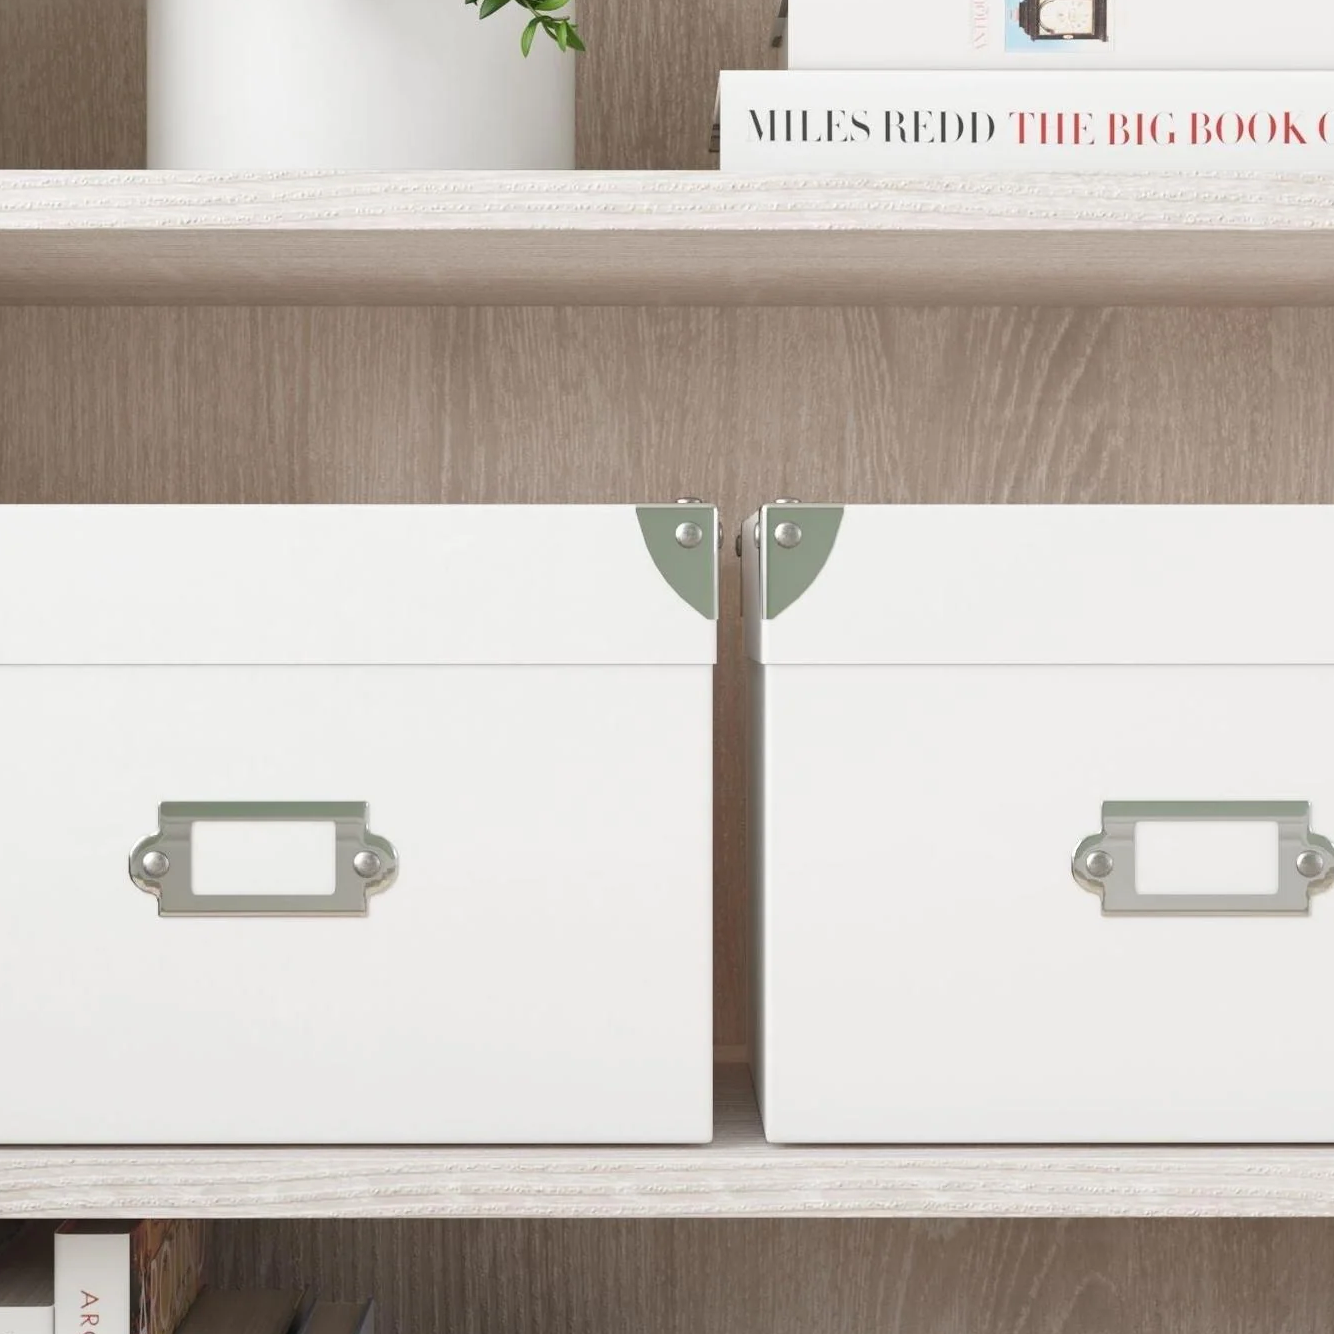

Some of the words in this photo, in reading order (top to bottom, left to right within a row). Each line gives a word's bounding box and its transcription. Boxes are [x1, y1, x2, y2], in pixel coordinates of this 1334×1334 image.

[746, 109, 871, 143] MILES
[883, 110, 996, 144] REDD
[1009, 111, 1095, 145] THE
[1107, 111, 1176, 146] BIG
[1190, 111, 1308, 145] BOOK
